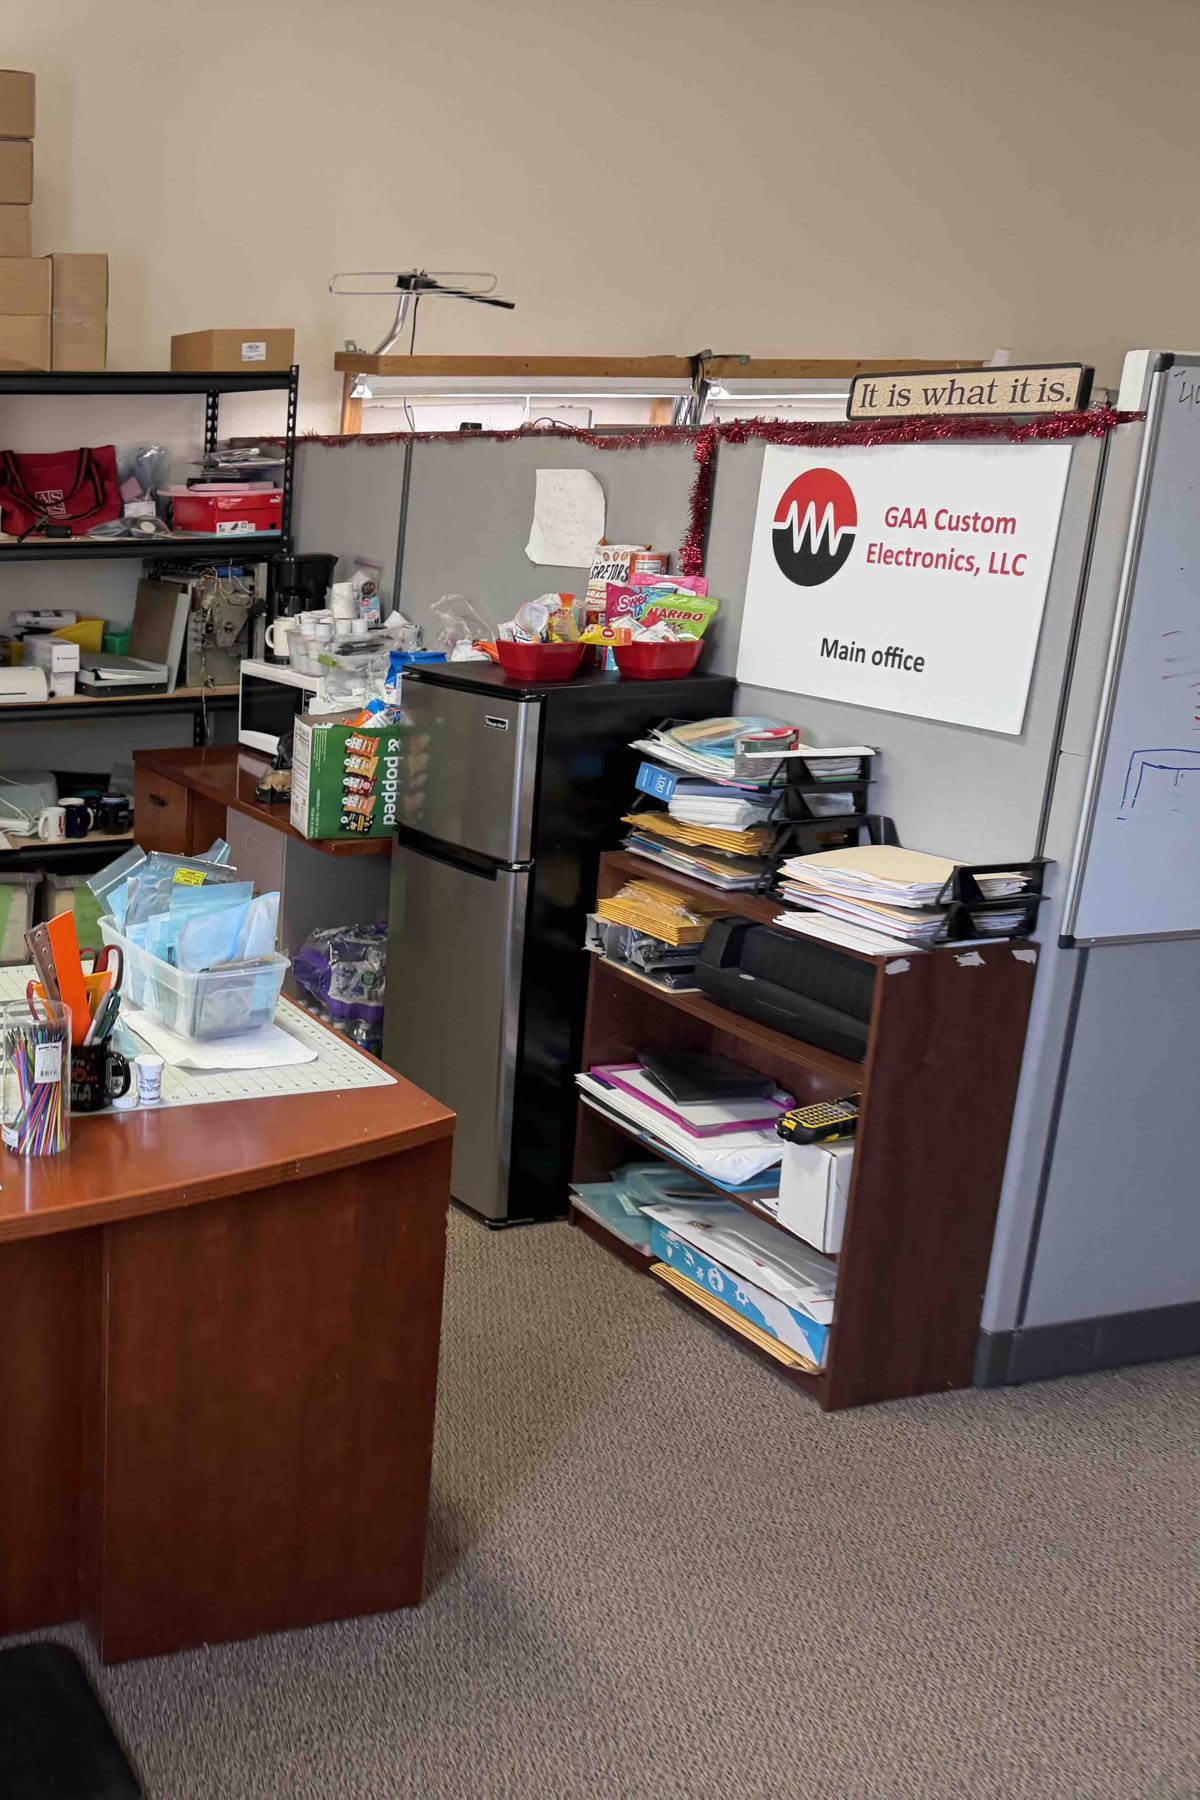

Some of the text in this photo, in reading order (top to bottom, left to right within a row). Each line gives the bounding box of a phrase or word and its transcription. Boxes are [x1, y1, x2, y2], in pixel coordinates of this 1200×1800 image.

[859, 377, 1071, 408] It is what it is.
[884, 506, 1017, 535] GAA Custom
[866, 542, 1028, 577] Electronics, LLC
[647, 606, 705, 622] HARIBO
[820, 637, 925, 673] Main office
